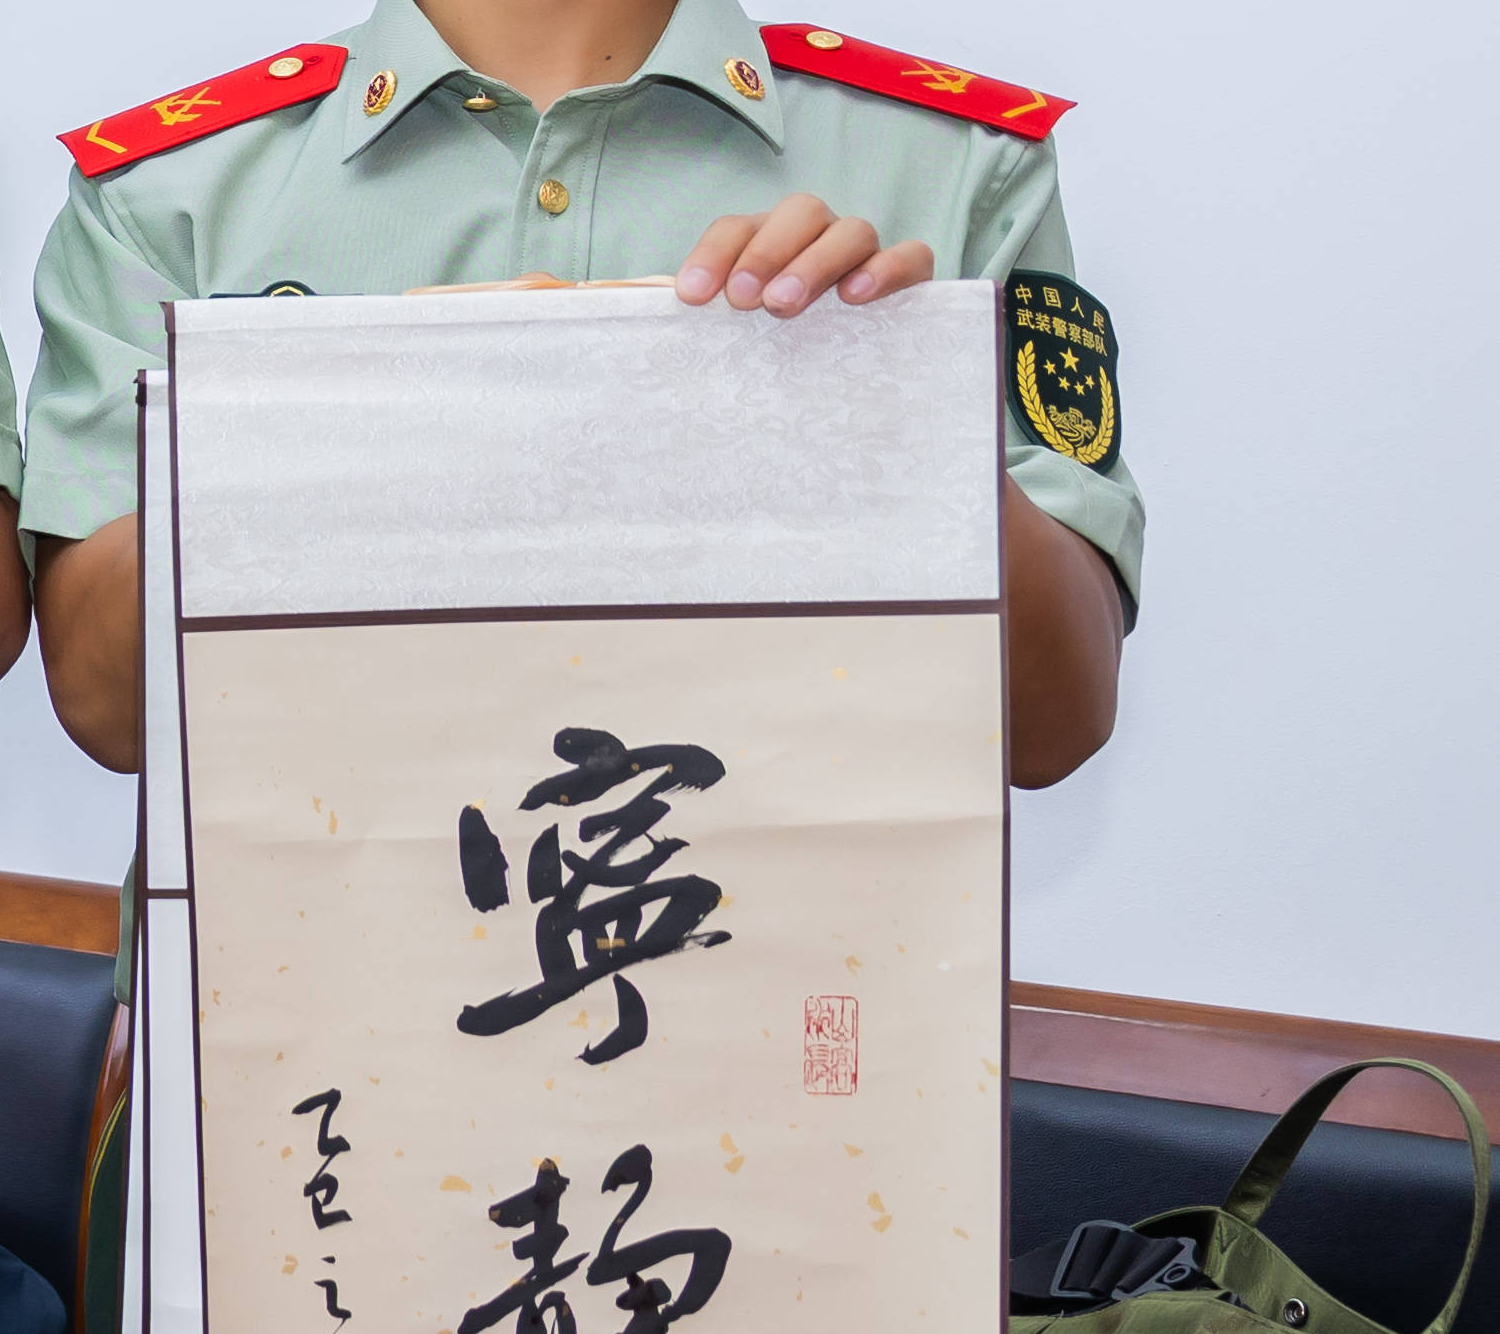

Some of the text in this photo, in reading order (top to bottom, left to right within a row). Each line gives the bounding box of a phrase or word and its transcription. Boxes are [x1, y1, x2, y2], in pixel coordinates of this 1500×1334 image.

[1014, 283, 1105, 334] 中国人民
[1016, 308, 1108, 357] 武装警察部队
